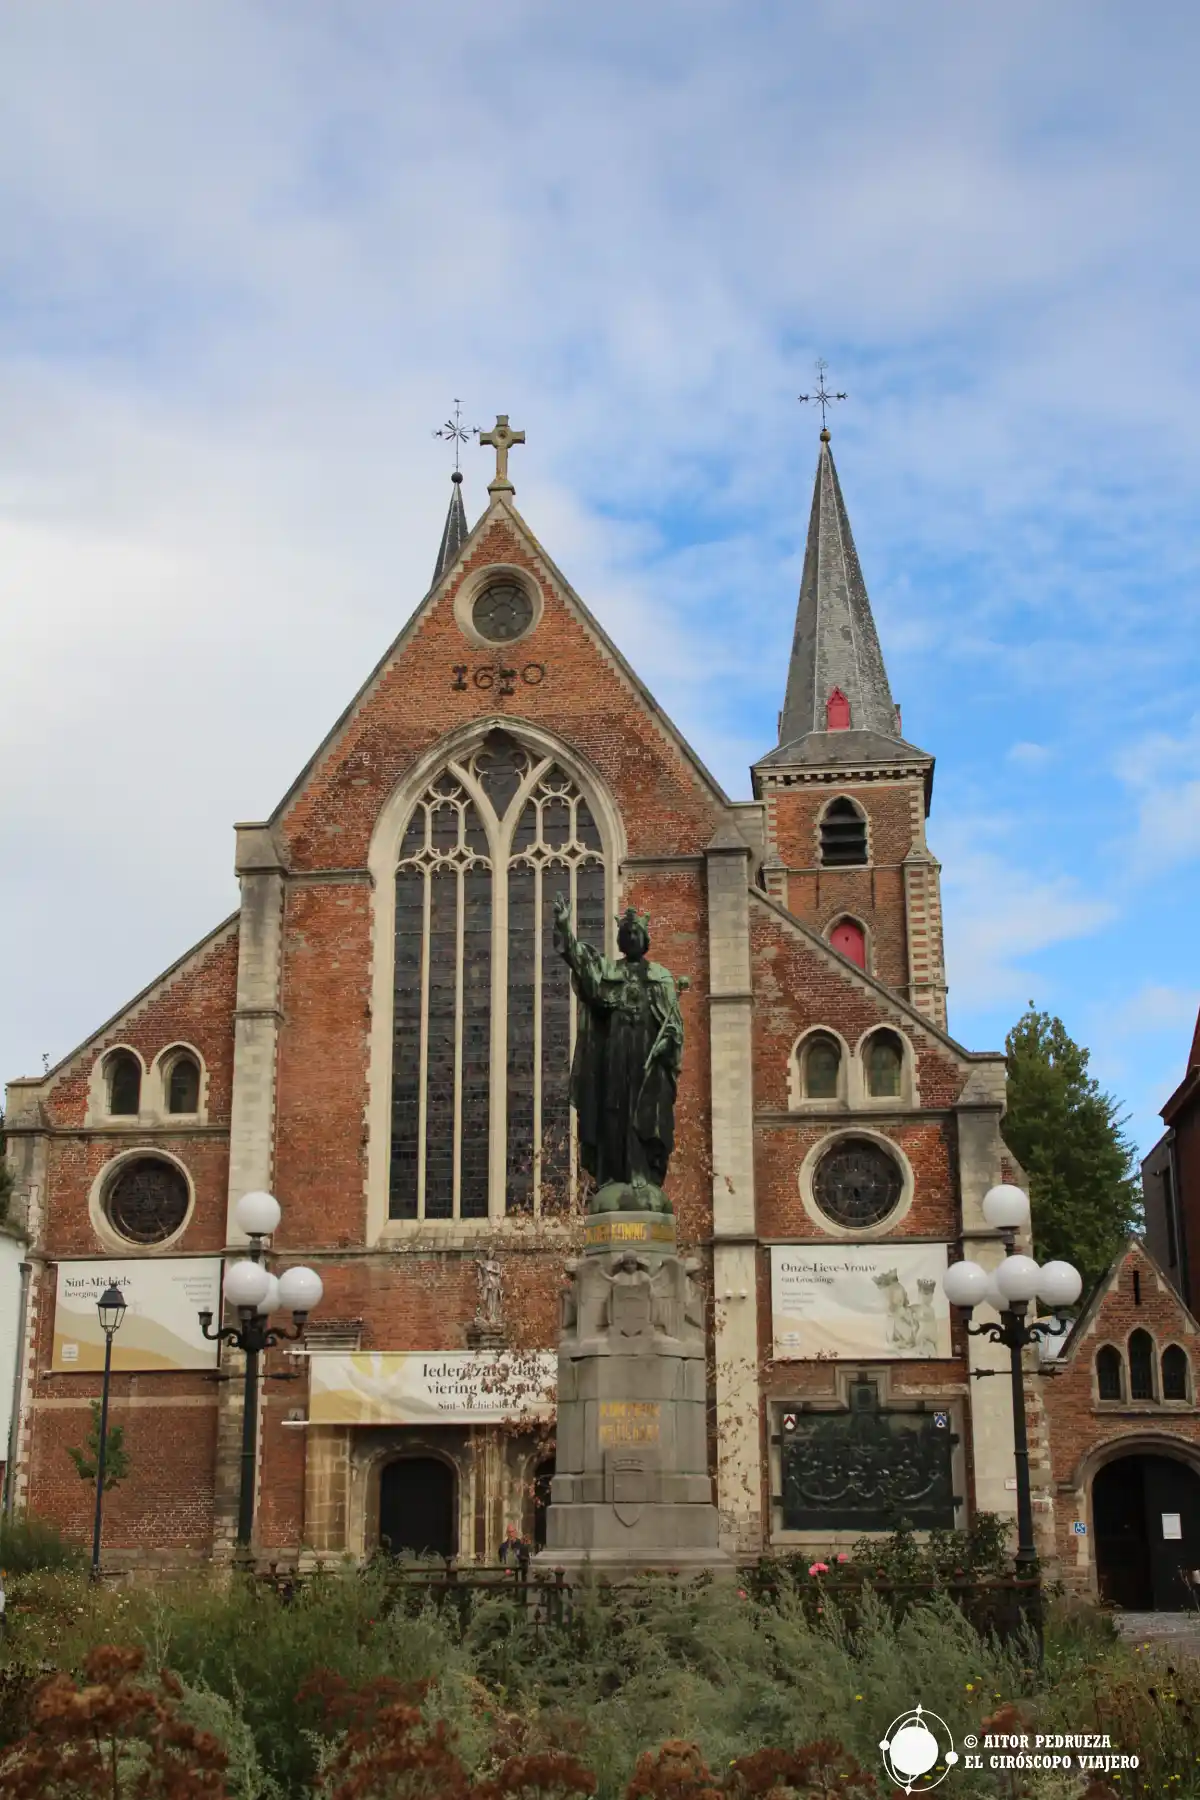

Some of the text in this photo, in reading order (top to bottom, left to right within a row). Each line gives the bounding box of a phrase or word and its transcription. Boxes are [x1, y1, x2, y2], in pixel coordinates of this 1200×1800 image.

[781, 1262, 877, 1273] Onze-Lieve-Vrouw
[64, 1276, 131, 1287] Sint-Michiels
[64, 1290, 98, 1298] beweging
[427, 1382, 477, 1397] viering
